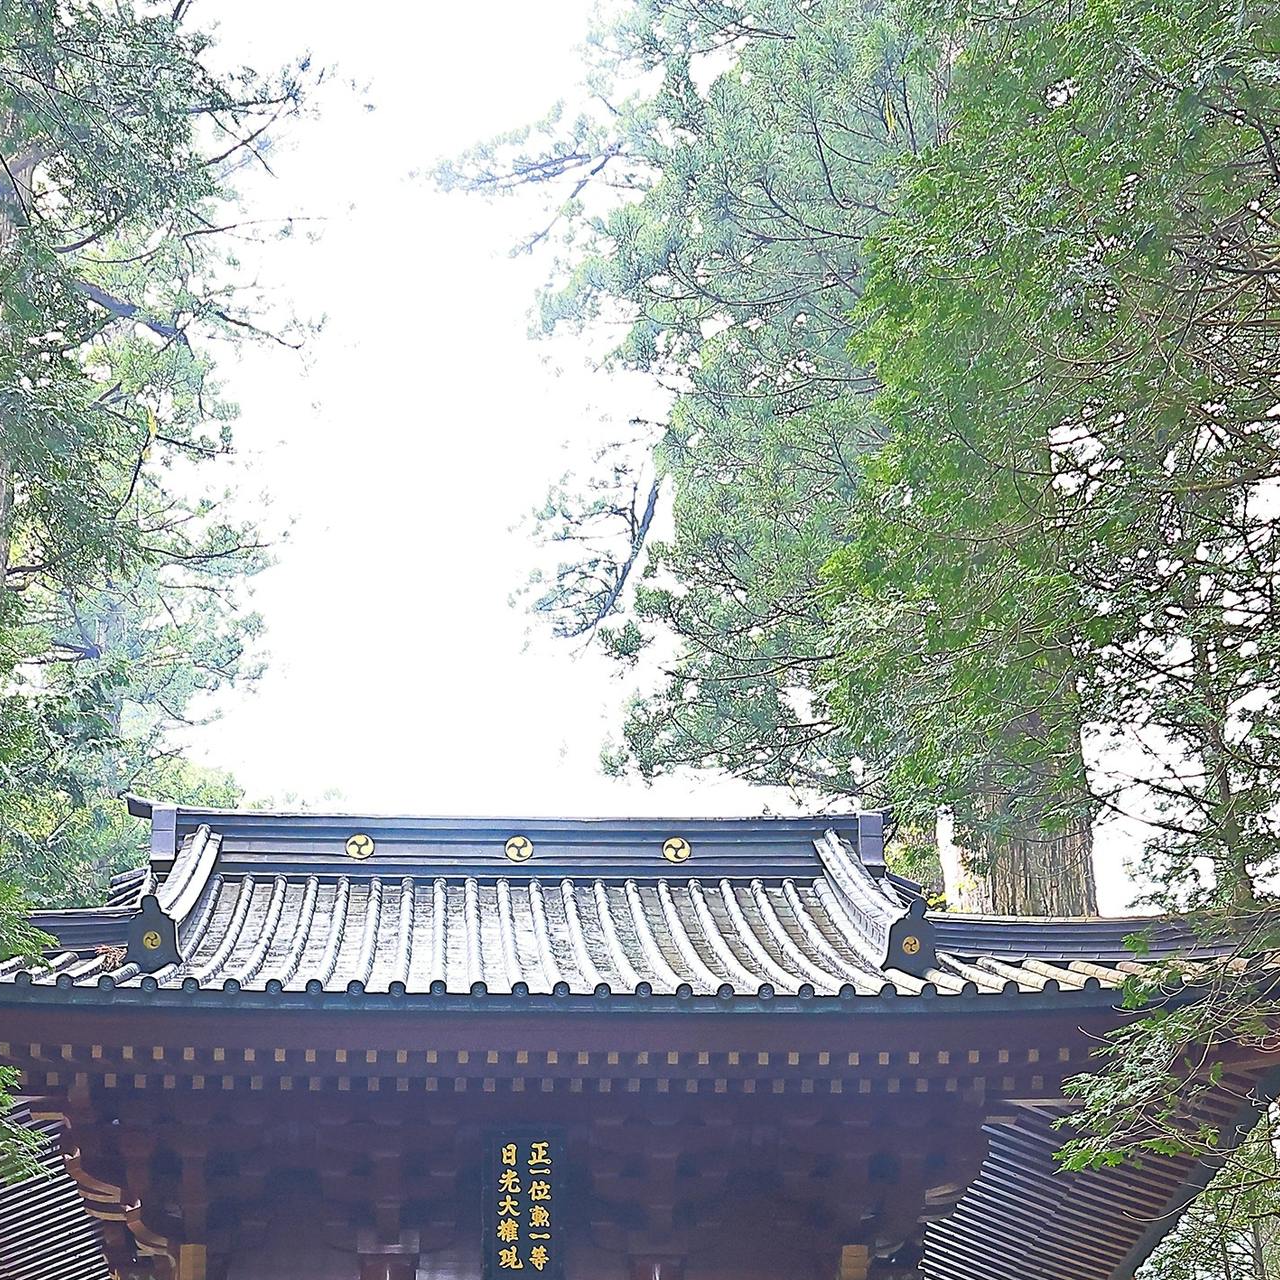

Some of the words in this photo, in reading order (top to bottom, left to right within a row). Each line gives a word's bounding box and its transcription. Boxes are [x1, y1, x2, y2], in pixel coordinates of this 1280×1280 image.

[497, 1143, 524, 1270] 日光大権現
[527, 1141, 552, 1271] 正一位勲一等
